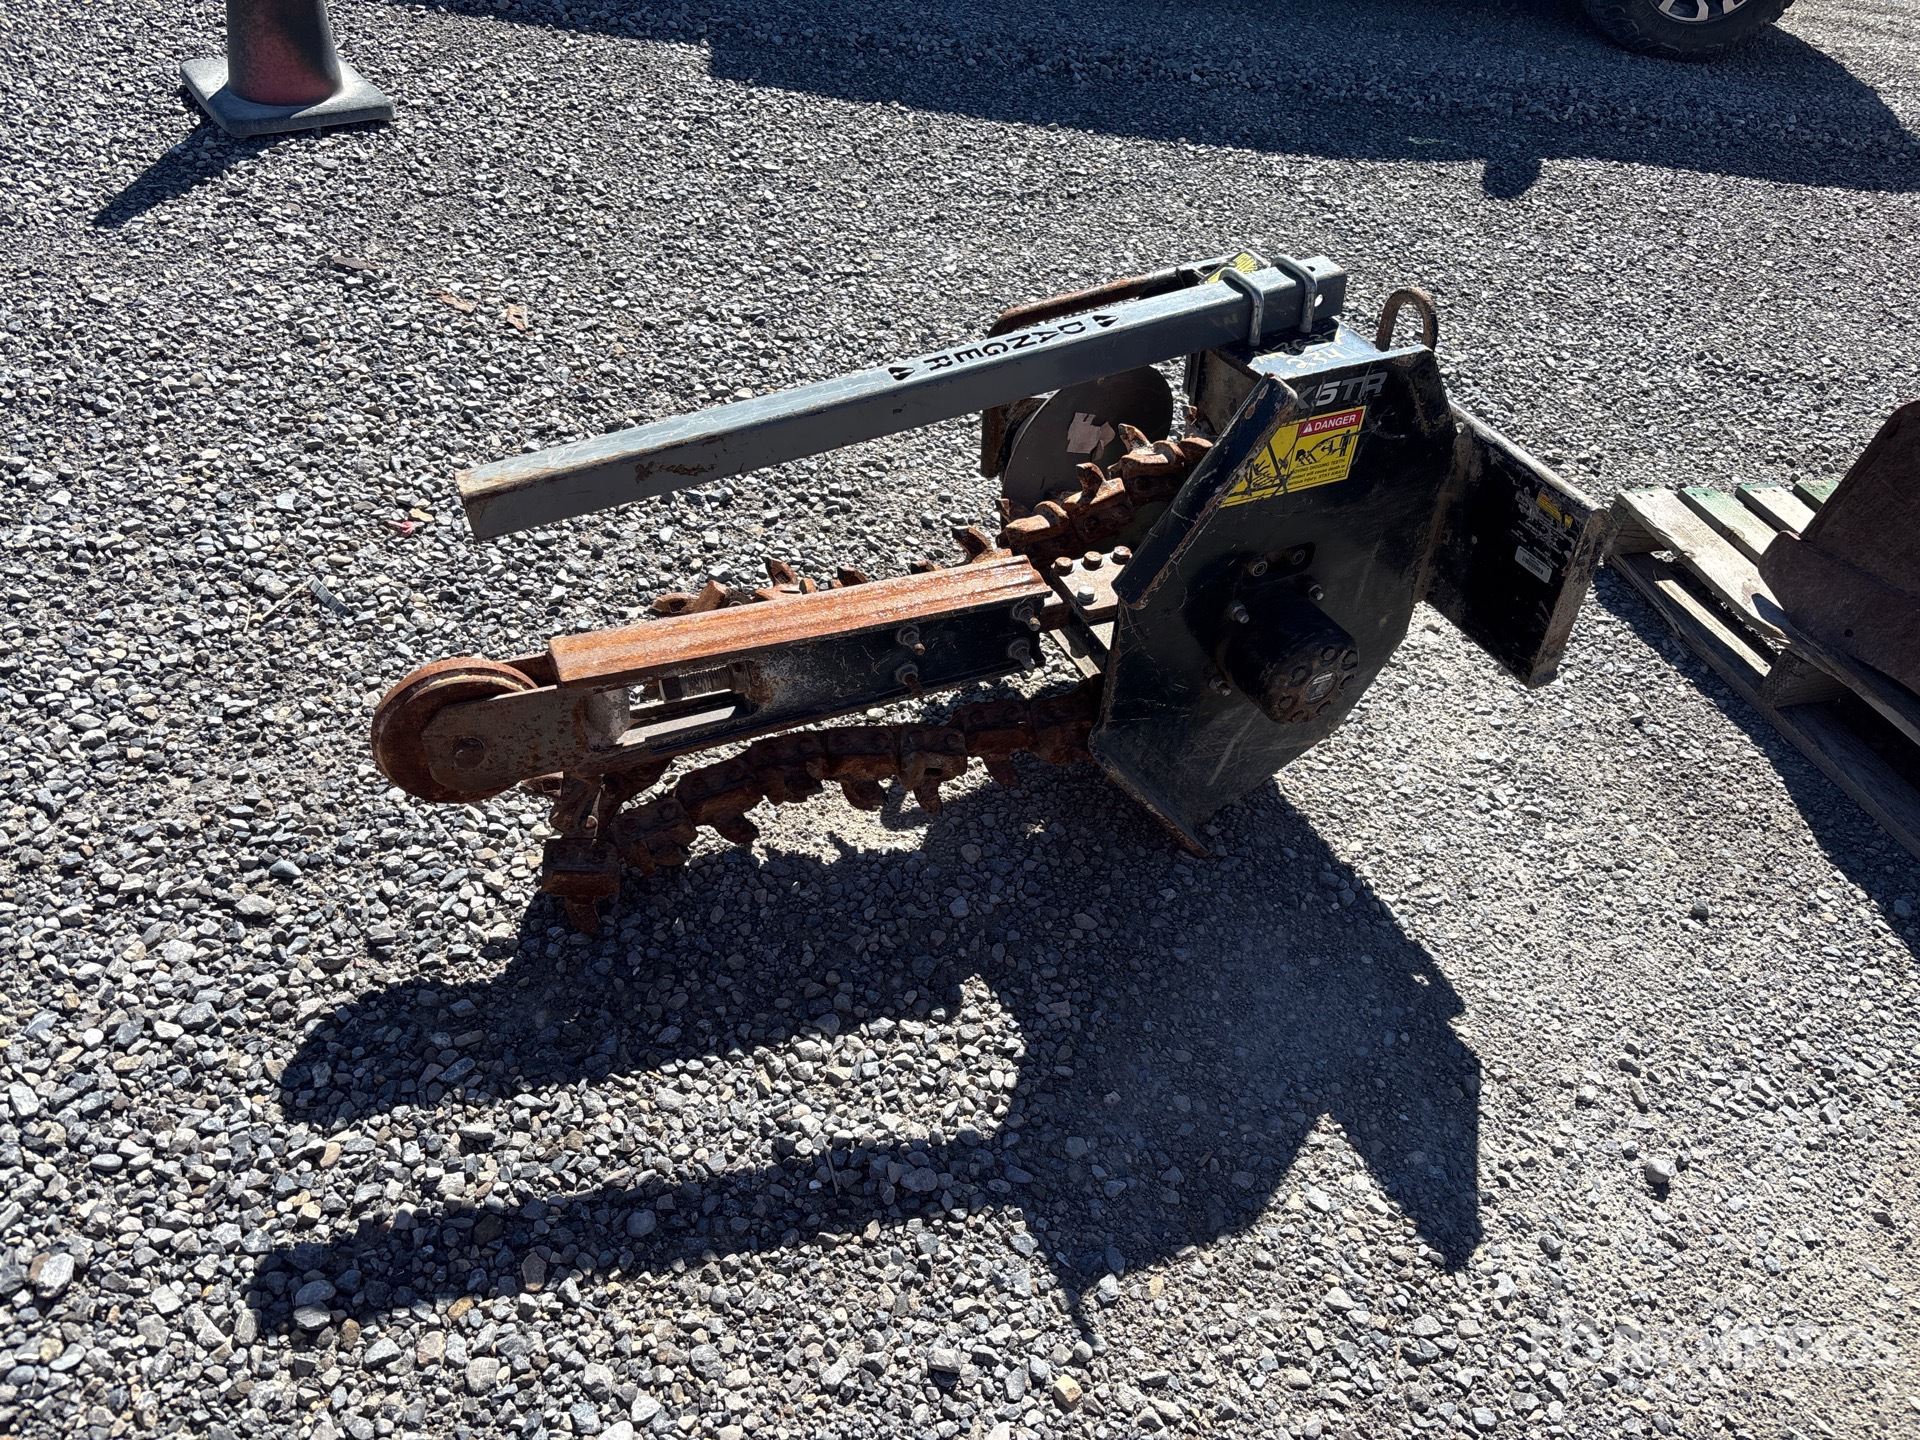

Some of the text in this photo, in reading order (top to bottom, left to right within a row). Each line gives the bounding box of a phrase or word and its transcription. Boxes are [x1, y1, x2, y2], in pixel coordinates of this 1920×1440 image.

[923, 321, 1086, 371] DANGER
[1314, 414, 1356, 431] DANGER
[1309, 462, 1330, 471] DIGGING
